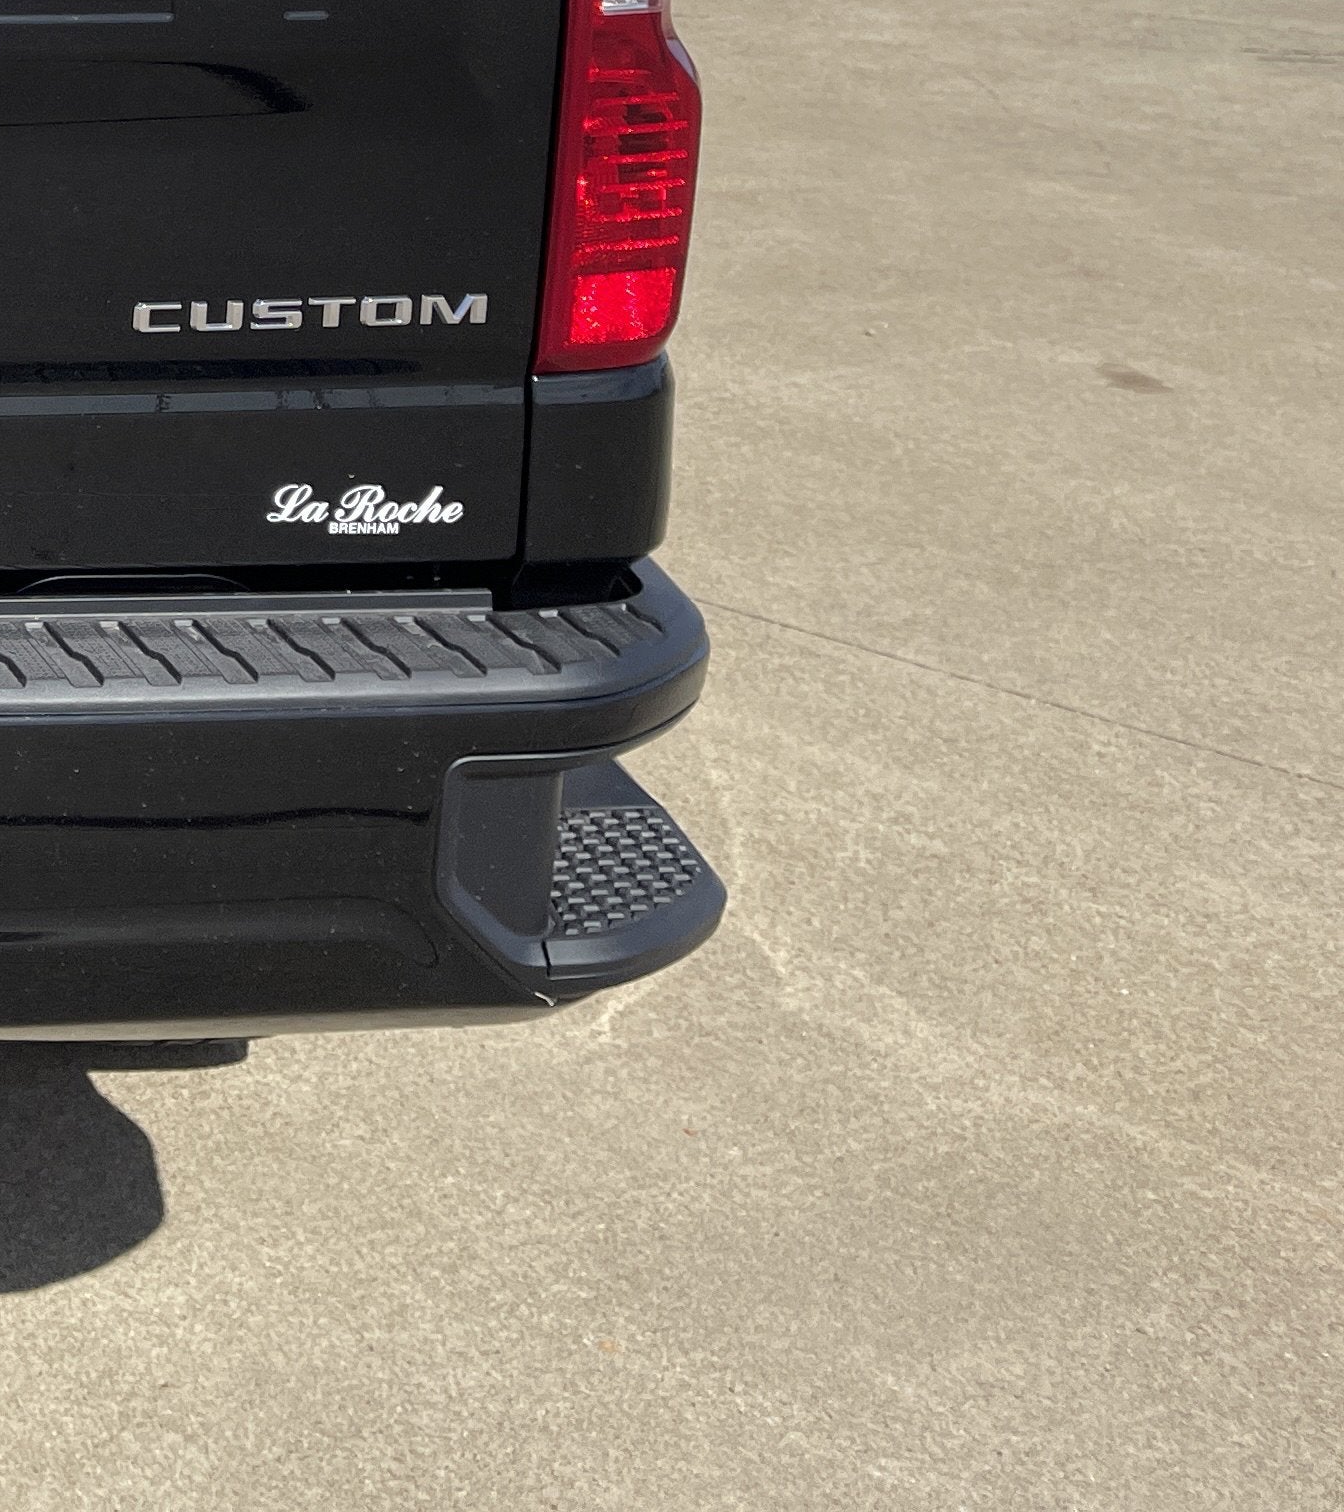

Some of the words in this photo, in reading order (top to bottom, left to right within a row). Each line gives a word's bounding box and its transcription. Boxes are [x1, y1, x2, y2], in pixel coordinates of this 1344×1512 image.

[132, 293, 487, 333] CUSTOM
[266, 483, 329, 523] La
[334, 484, 463, 523] Roche
[328, 522, 399, 534] BRENHAM
